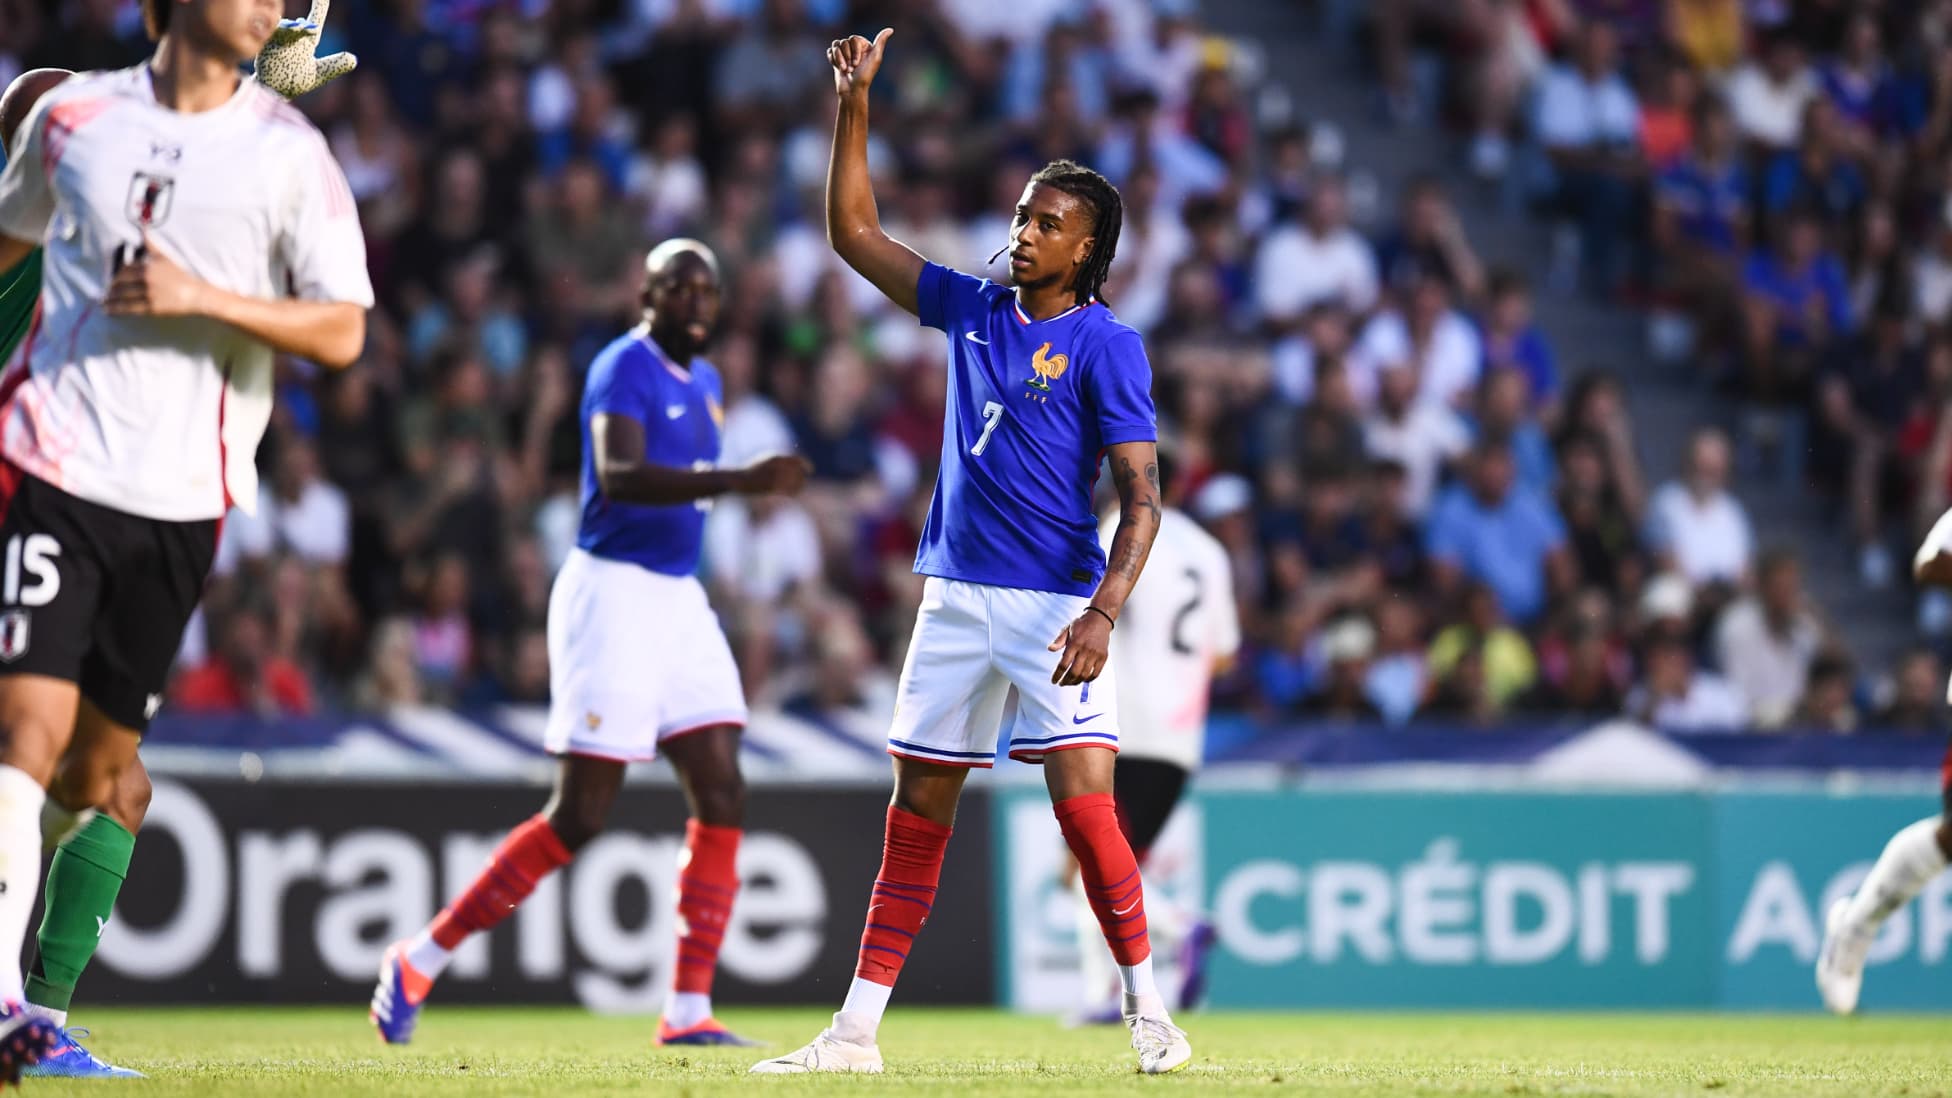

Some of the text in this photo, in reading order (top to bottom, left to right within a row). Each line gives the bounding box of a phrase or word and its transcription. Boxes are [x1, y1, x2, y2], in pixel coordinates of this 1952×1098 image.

[970, 401, 1003, 457] 7
[4, 532, 62, 607] 15
[92, 777, 828, 1014] Orange
[1215, 834, 1694, 967] CRÉDIT
